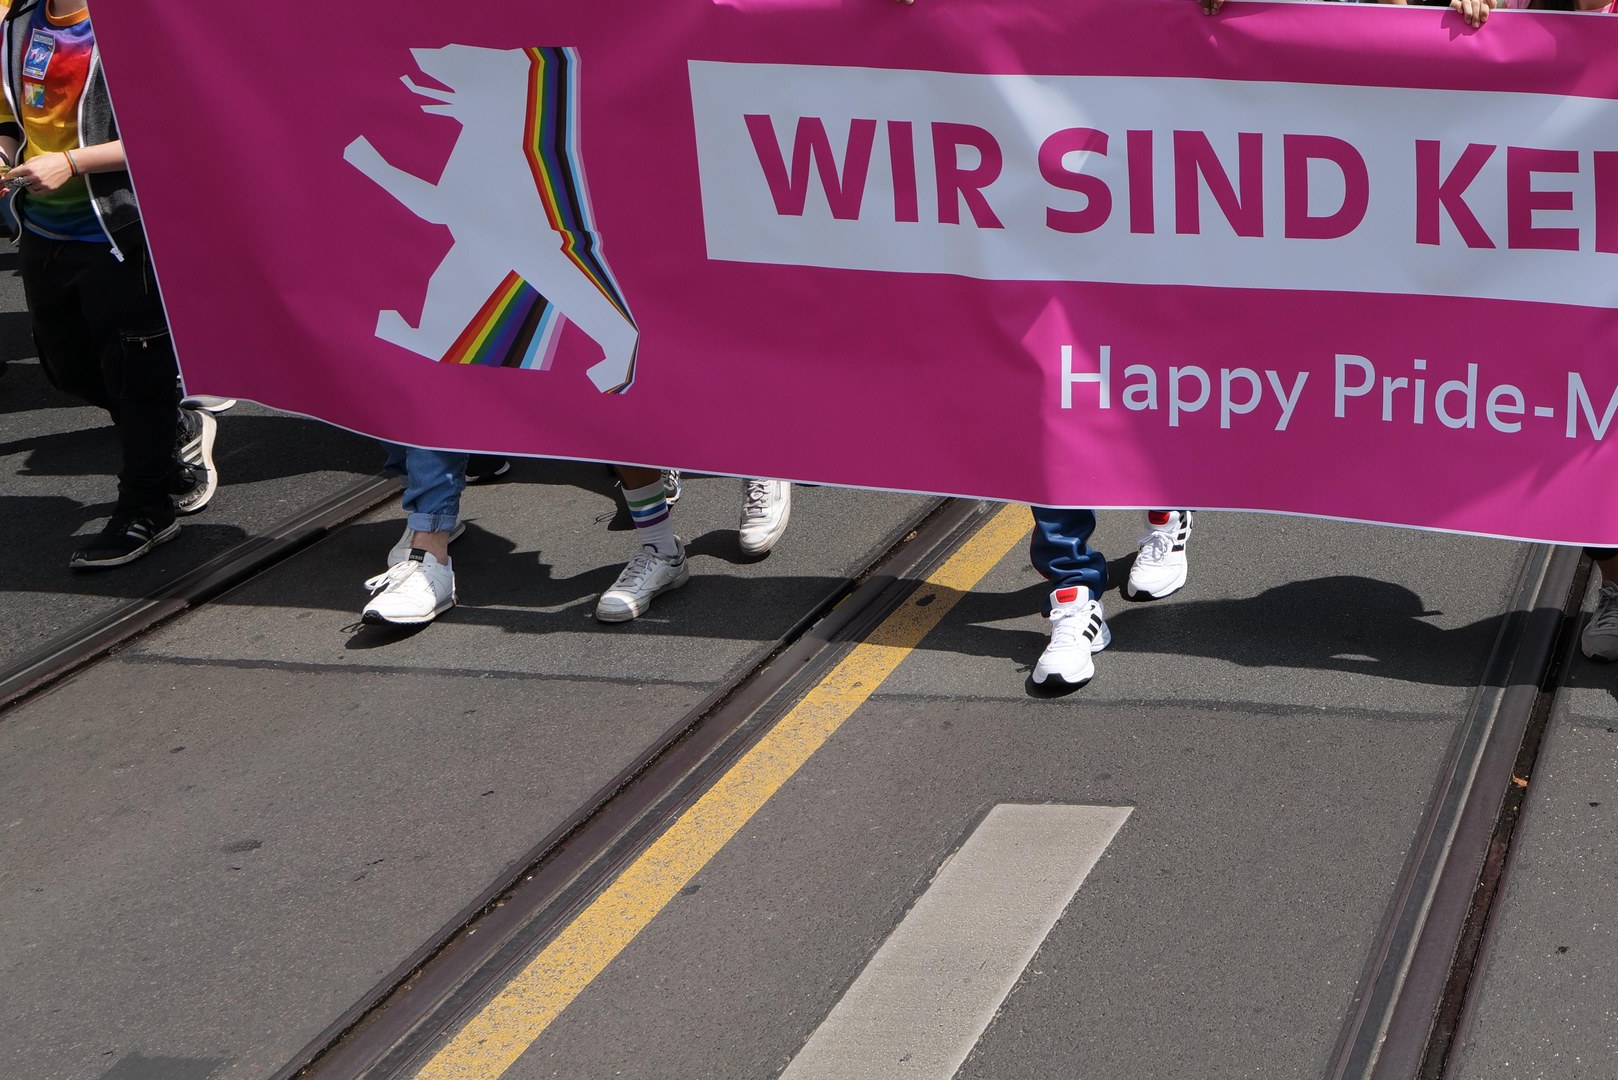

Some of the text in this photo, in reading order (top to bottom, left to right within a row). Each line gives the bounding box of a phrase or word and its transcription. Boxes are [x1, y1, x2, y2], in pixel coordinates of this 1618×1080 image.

[744, 115, 1004, 228] WIR
[1039, 128, 1369, 239] SIND
[1061, 345, 1309, 430] Happy
